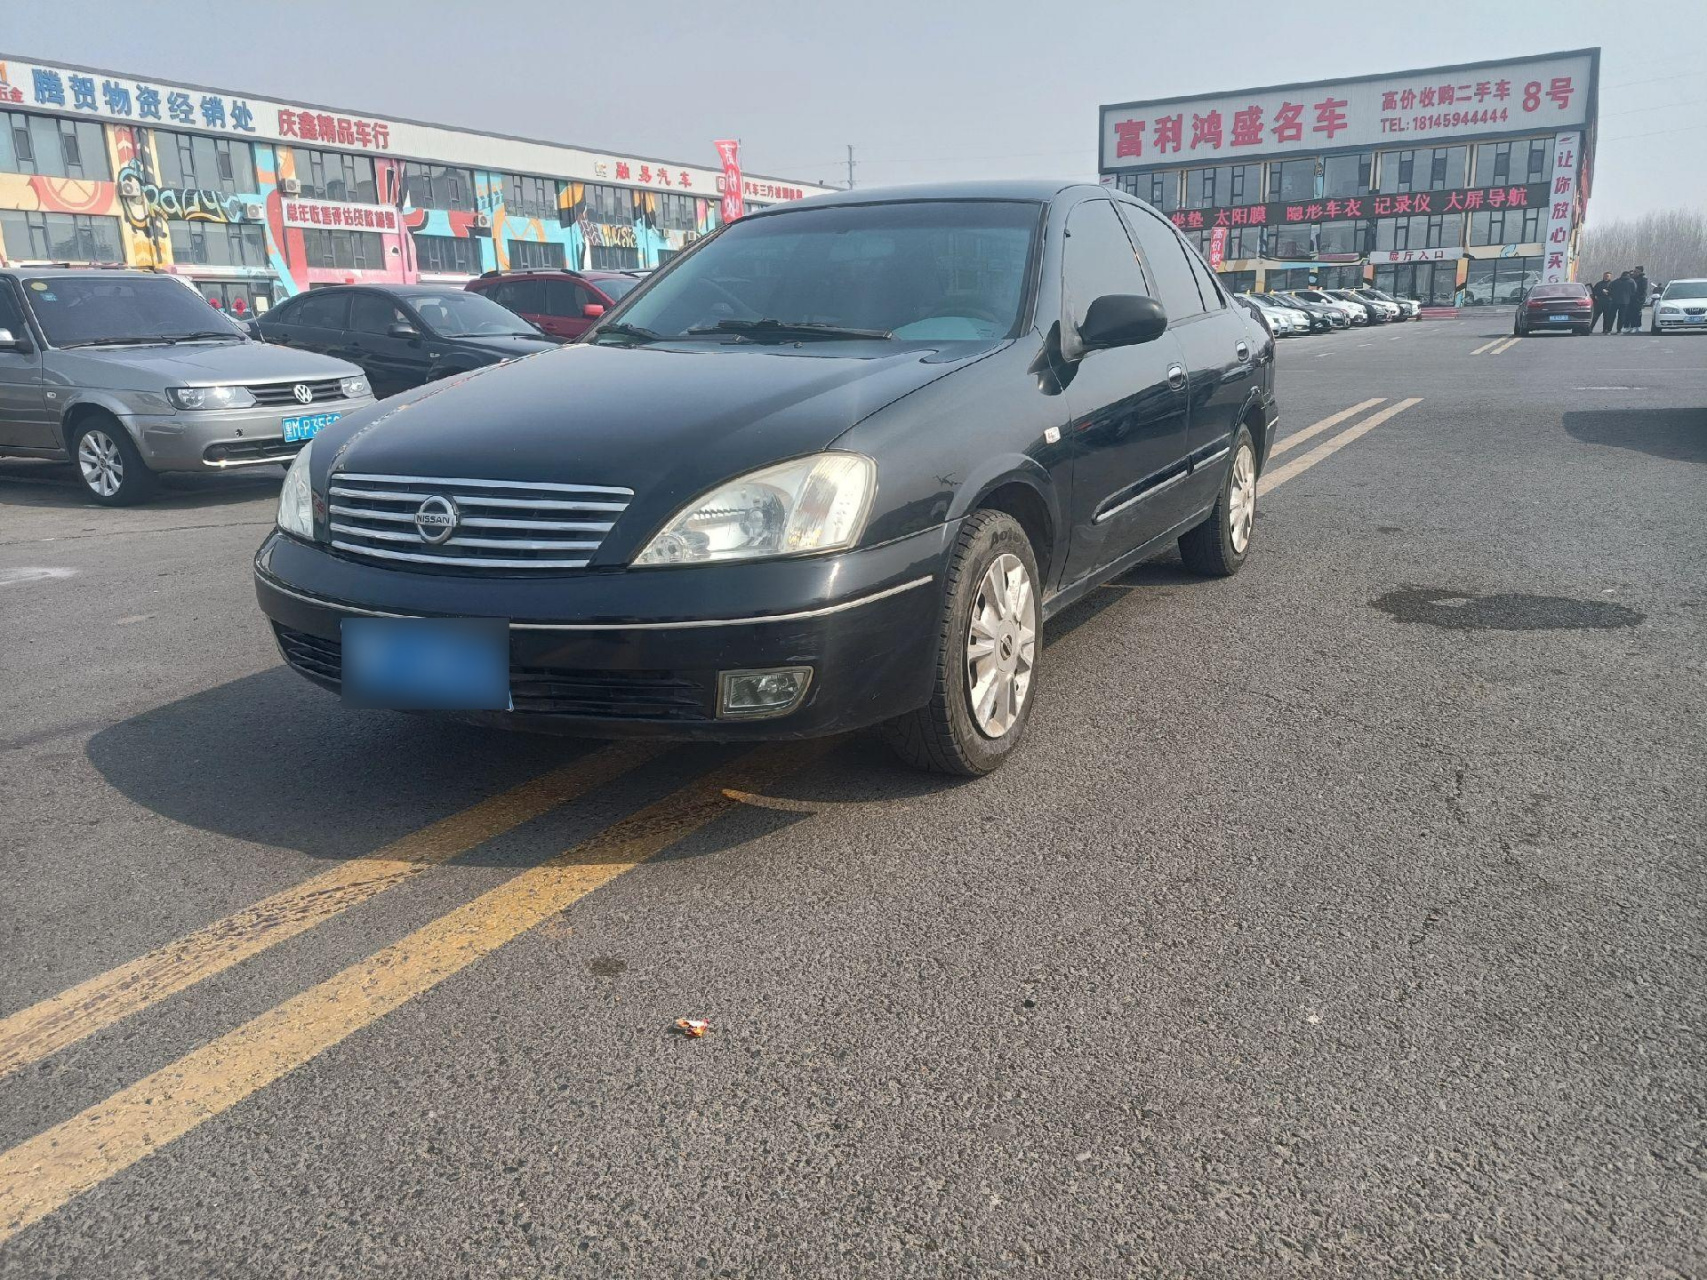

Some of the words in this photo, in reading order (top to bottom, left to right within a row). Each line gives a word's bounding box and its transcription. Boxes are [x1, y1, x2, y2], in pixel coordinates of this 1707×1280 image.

[31, 68, 256, 133] 腾贺物资经销处
[1381, 79, 1511, 111] 高价收购二手车
[1522, 77, 1575, 112] 8号
[277, 108, 390, 150] 庆鑫精品车行
[1114, 97, 1349, 158] 富利鸿盛名车
[615, 161, 692, 188] 融易汽车
[1213, 206, 1267, 226] 太阳膜
[1286, 199, 1362, 221] 隐形车衣
[1373, 193, 1431, 215] 记录仪
[1443, 187, 1528, 211] 大屏导航
[1547, 150, 1574, 270] 让你放心买
[1388, 250, 1444, 261] 展厅入口
[416, 513, 450, 524] NISSAN
